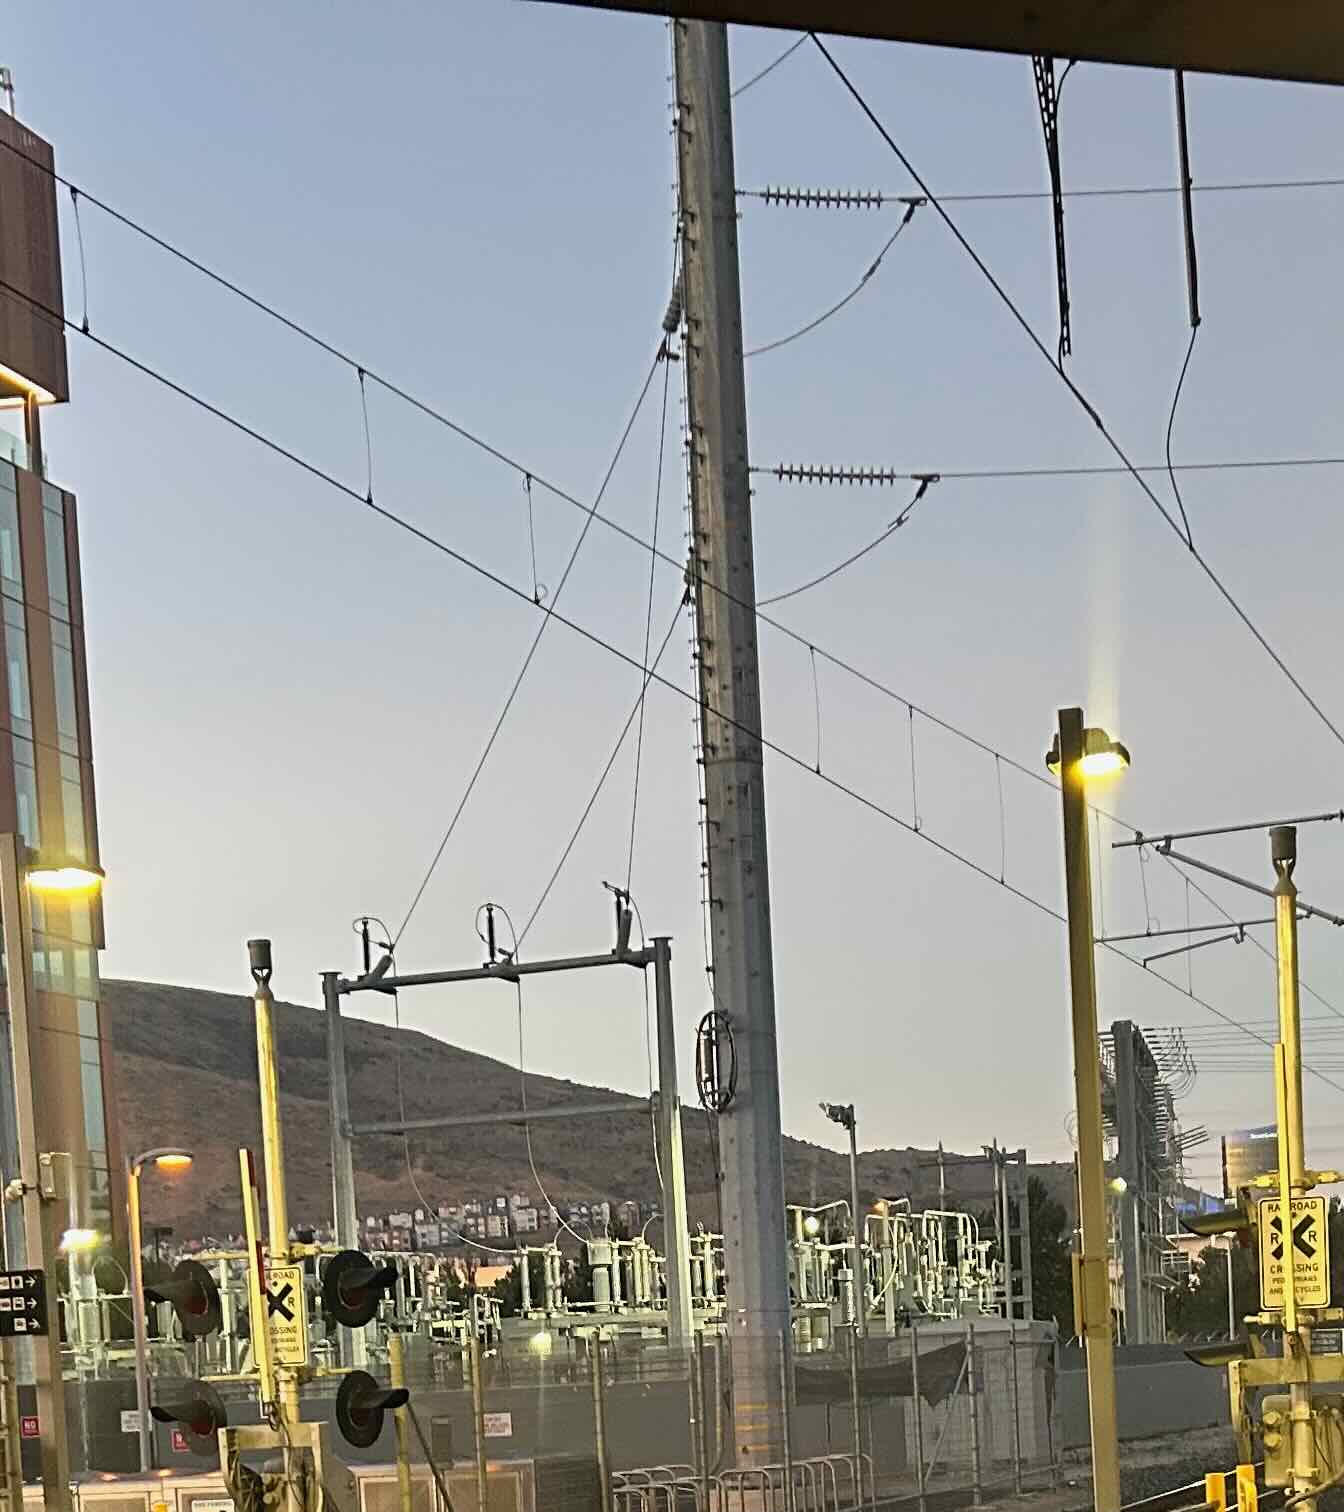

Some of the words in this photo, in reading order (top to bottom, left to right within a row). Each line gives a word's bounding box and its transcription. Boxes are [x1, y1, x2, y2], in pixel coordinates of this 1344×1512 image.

[1267, 1200, 1318, 1214] RAROAD
[1270, 1232, 1279, 1244] R
[1308, 1230, 1317, 1242] R
[1269, 1263, 1319, 1275] CRSING
